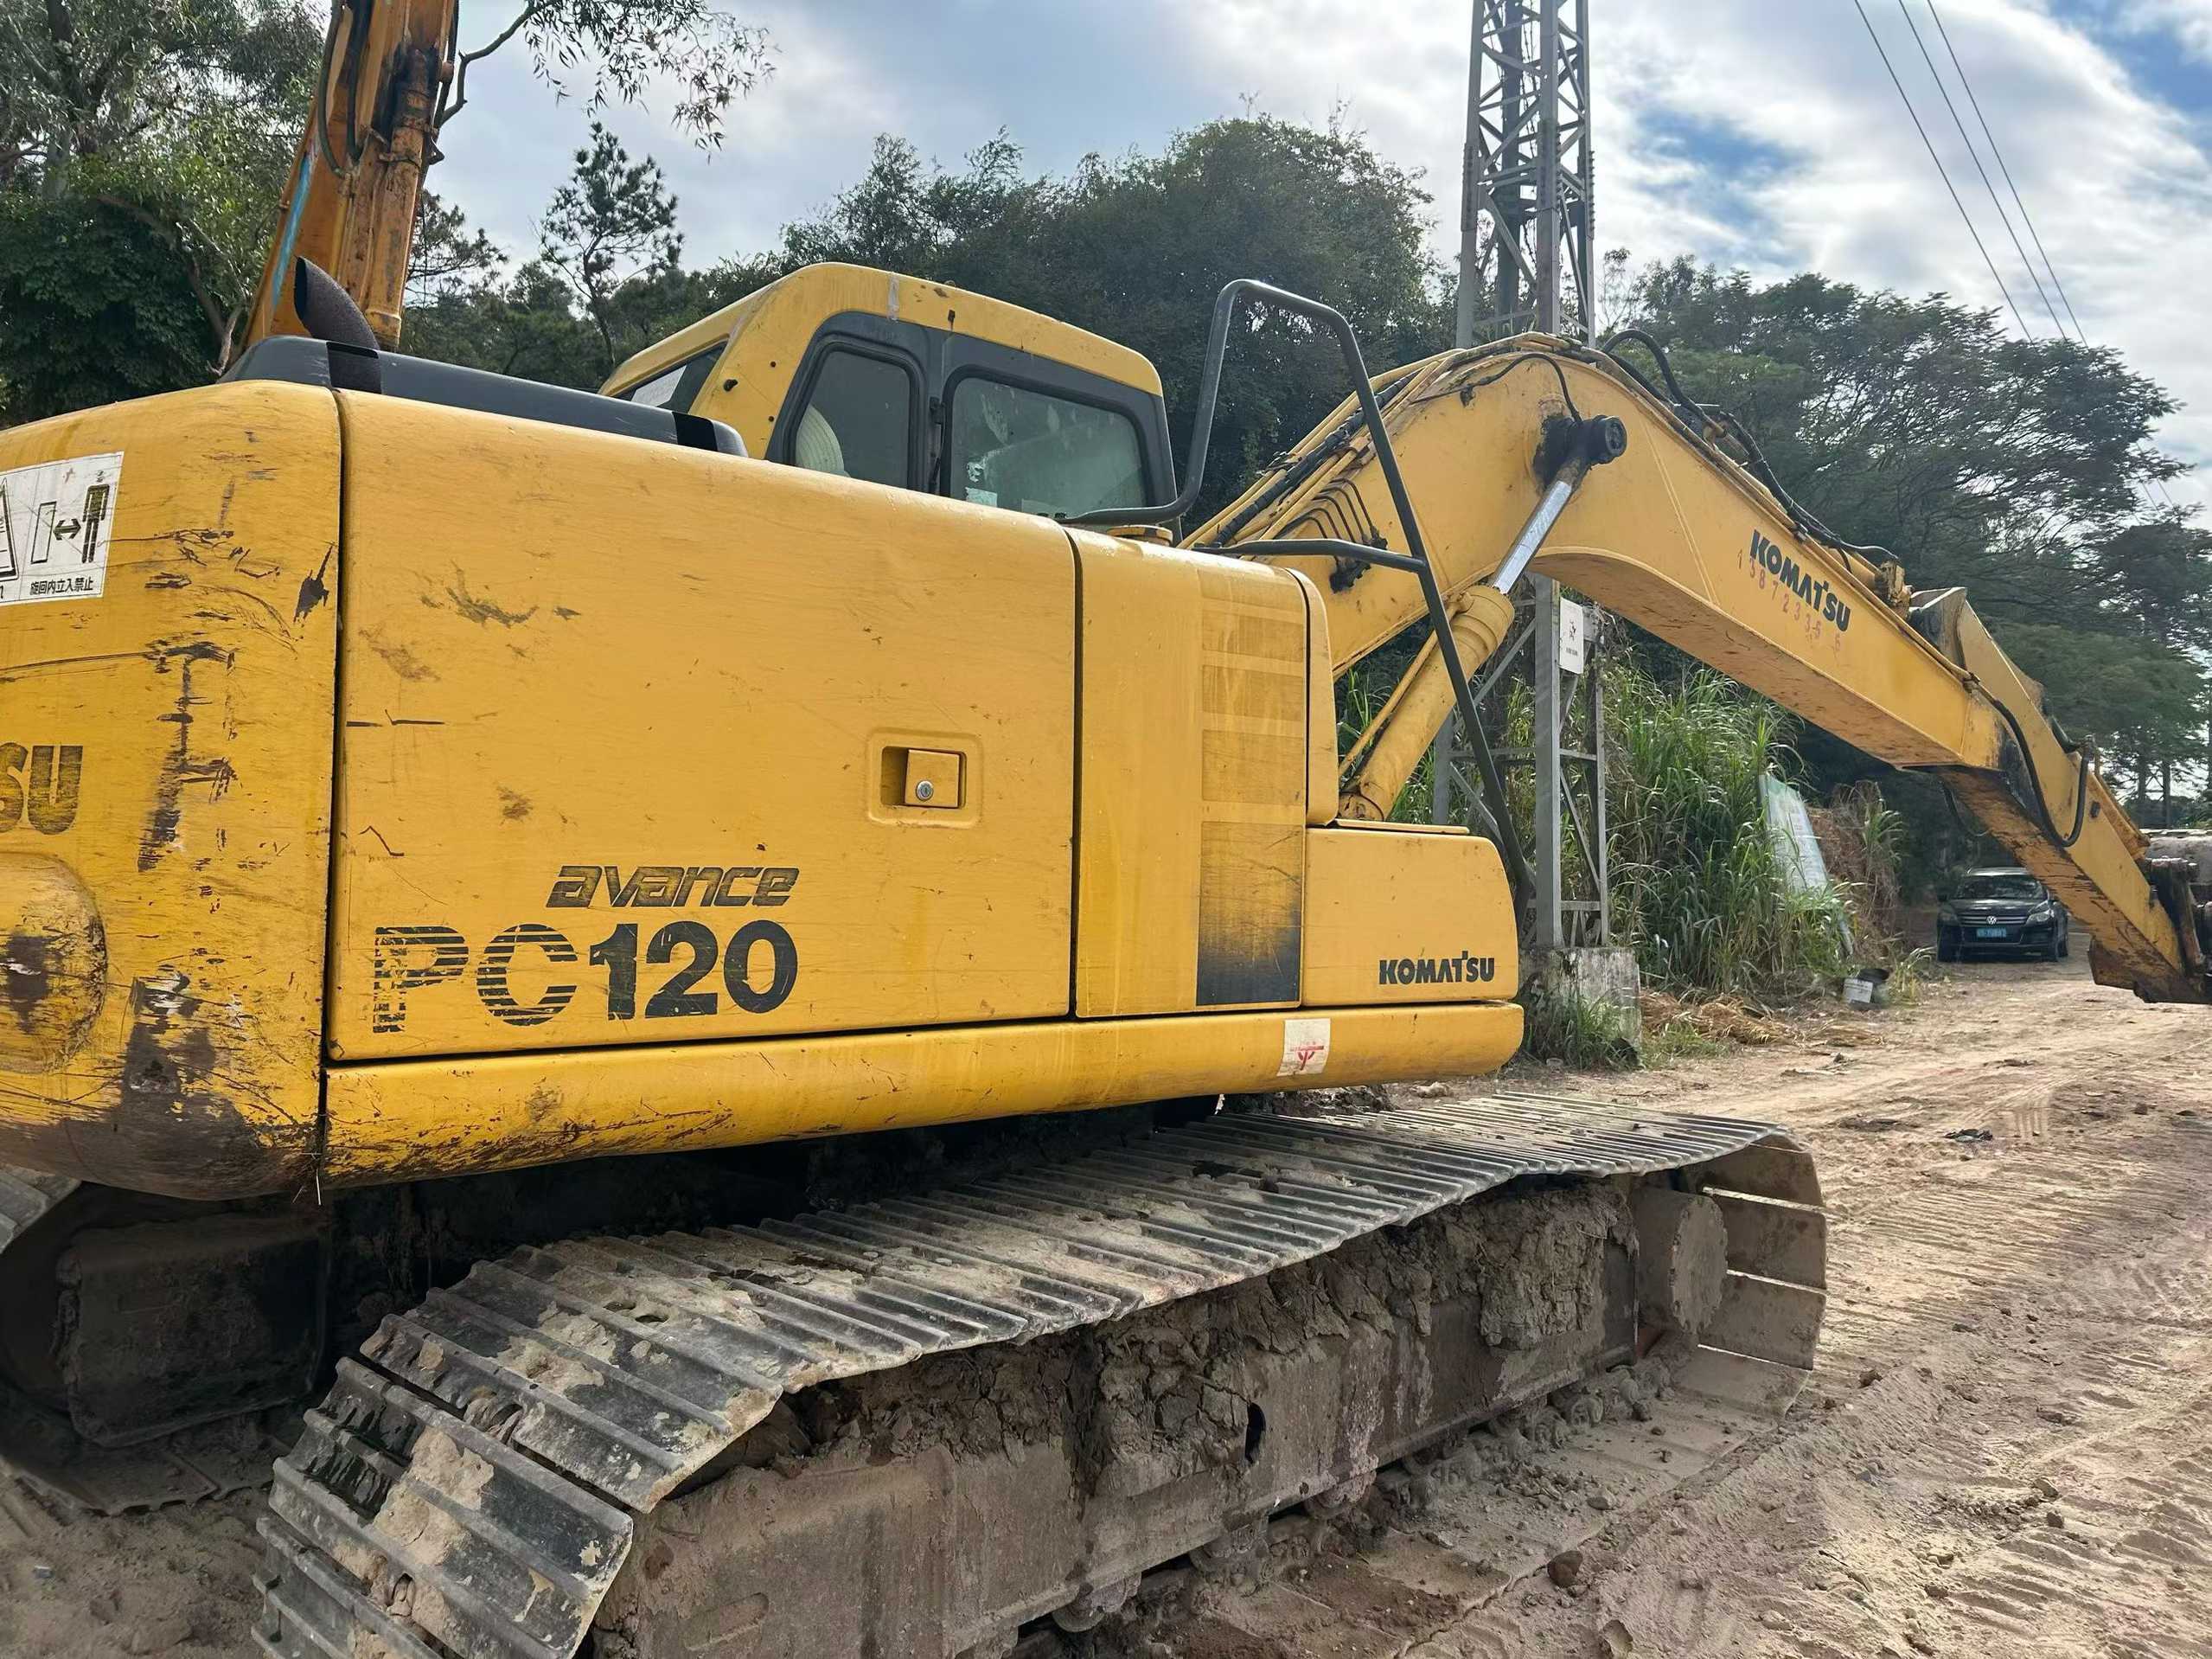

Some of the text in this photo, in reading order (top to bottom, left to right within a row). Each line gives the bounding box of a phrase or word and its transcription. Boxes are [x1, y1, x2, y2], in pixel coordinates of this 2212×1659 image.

[29, 576, 94, 596] 旋回内立入禁止
[1749, 529, 1851, 632] KOMATSU
[546, 865, 800, 908] avance
[373, 919, 798, 1033] PC120
[1379, 951, 1495, 984] KOMATSU
